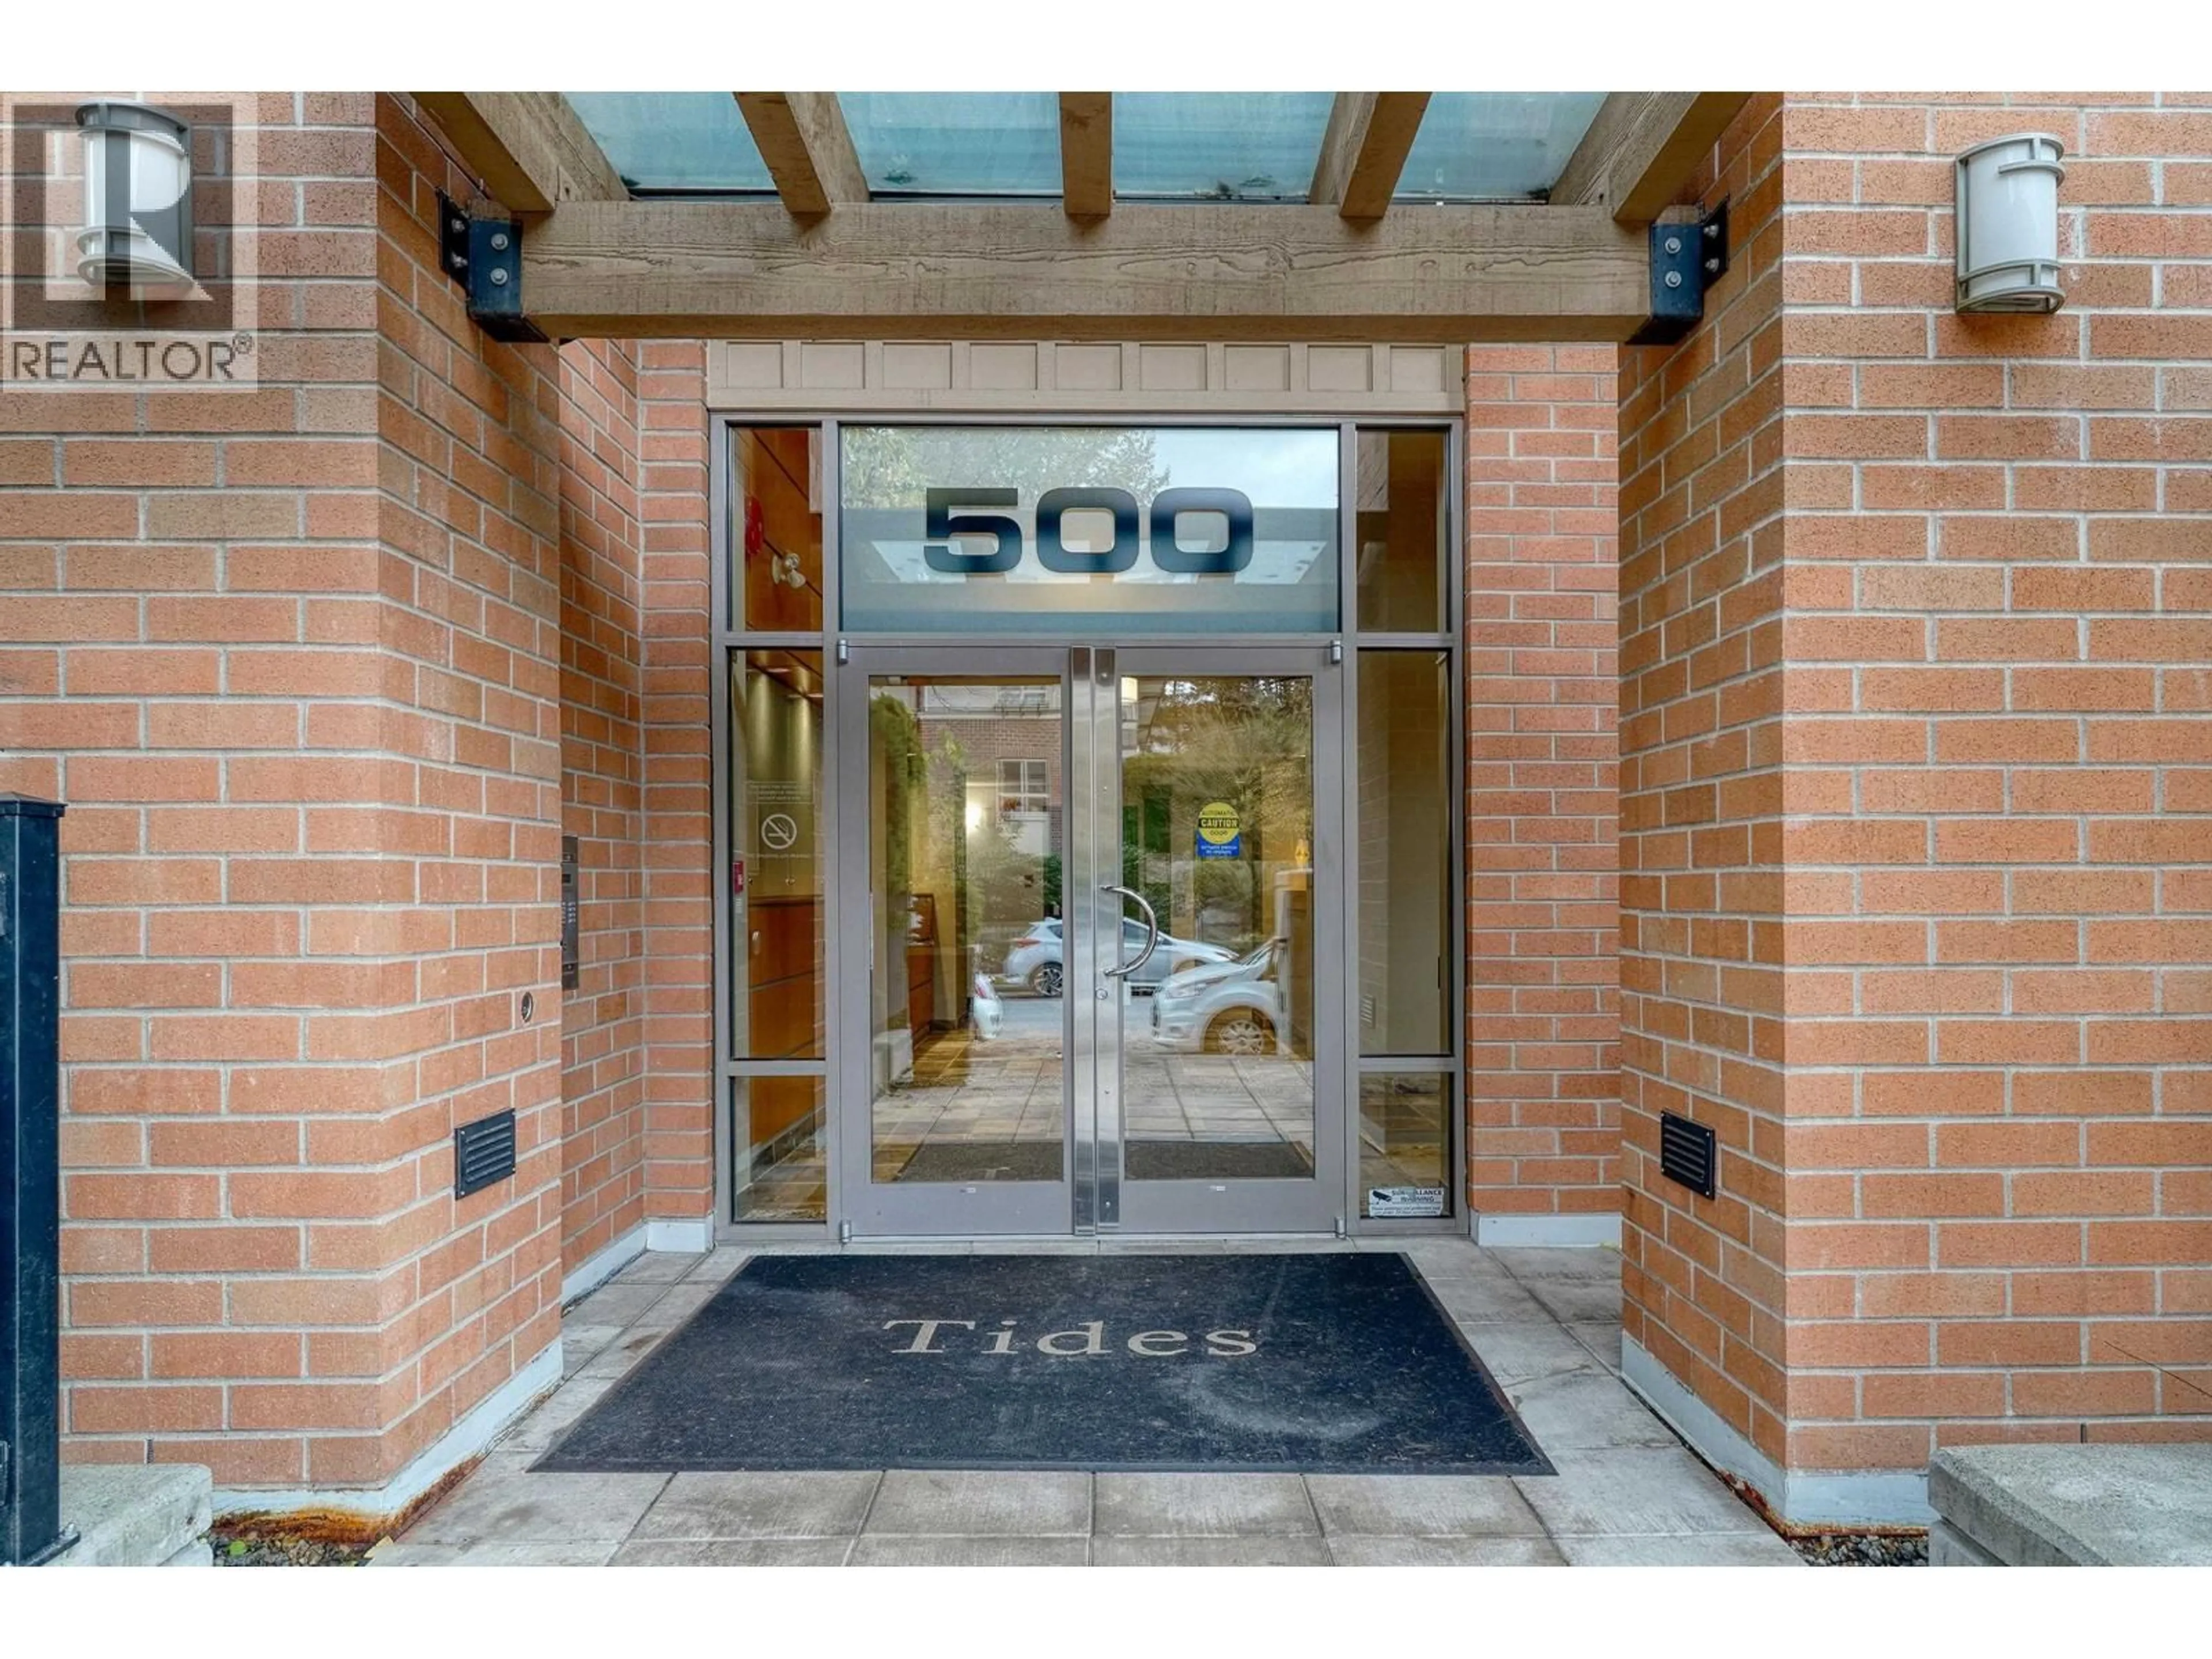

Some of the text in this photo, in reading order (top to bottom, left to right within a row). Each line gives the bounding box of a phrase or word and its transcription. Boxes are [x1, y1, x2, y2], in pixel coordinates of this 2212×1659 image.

[923, 487, 1254, 573] 500
[1200, 818, 1237, 827] CAUTION
[882, 1320, 1257, 1356] Tides
